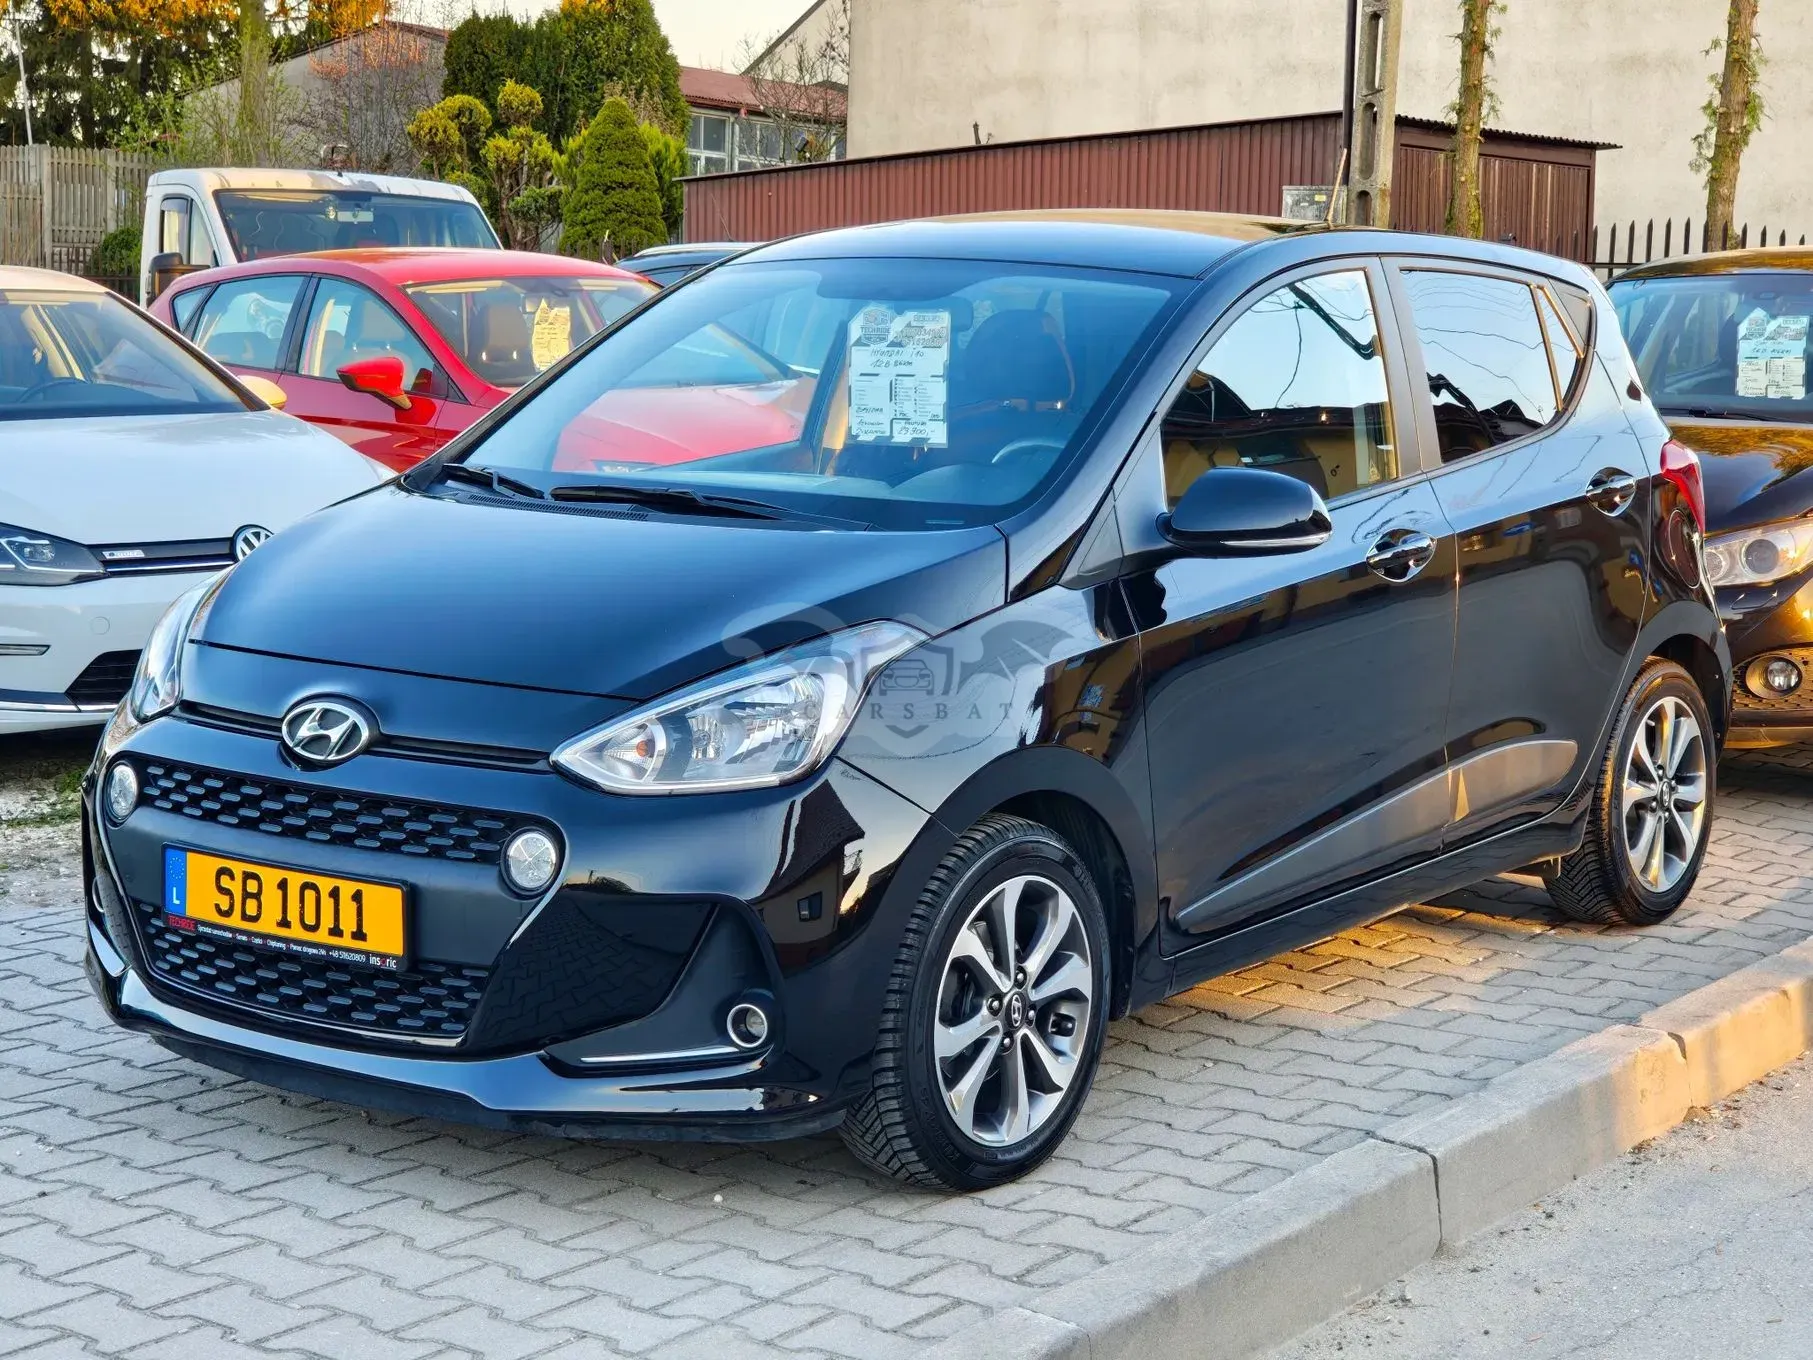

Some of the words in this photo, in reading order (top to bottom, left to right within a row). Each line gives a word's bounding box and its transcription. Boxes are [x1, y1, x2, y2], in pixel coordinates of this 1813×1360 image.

[172, 886, 181, 905] L
[214, 866, 262, 923] SB
[276, 877, 367, 942] 1011
